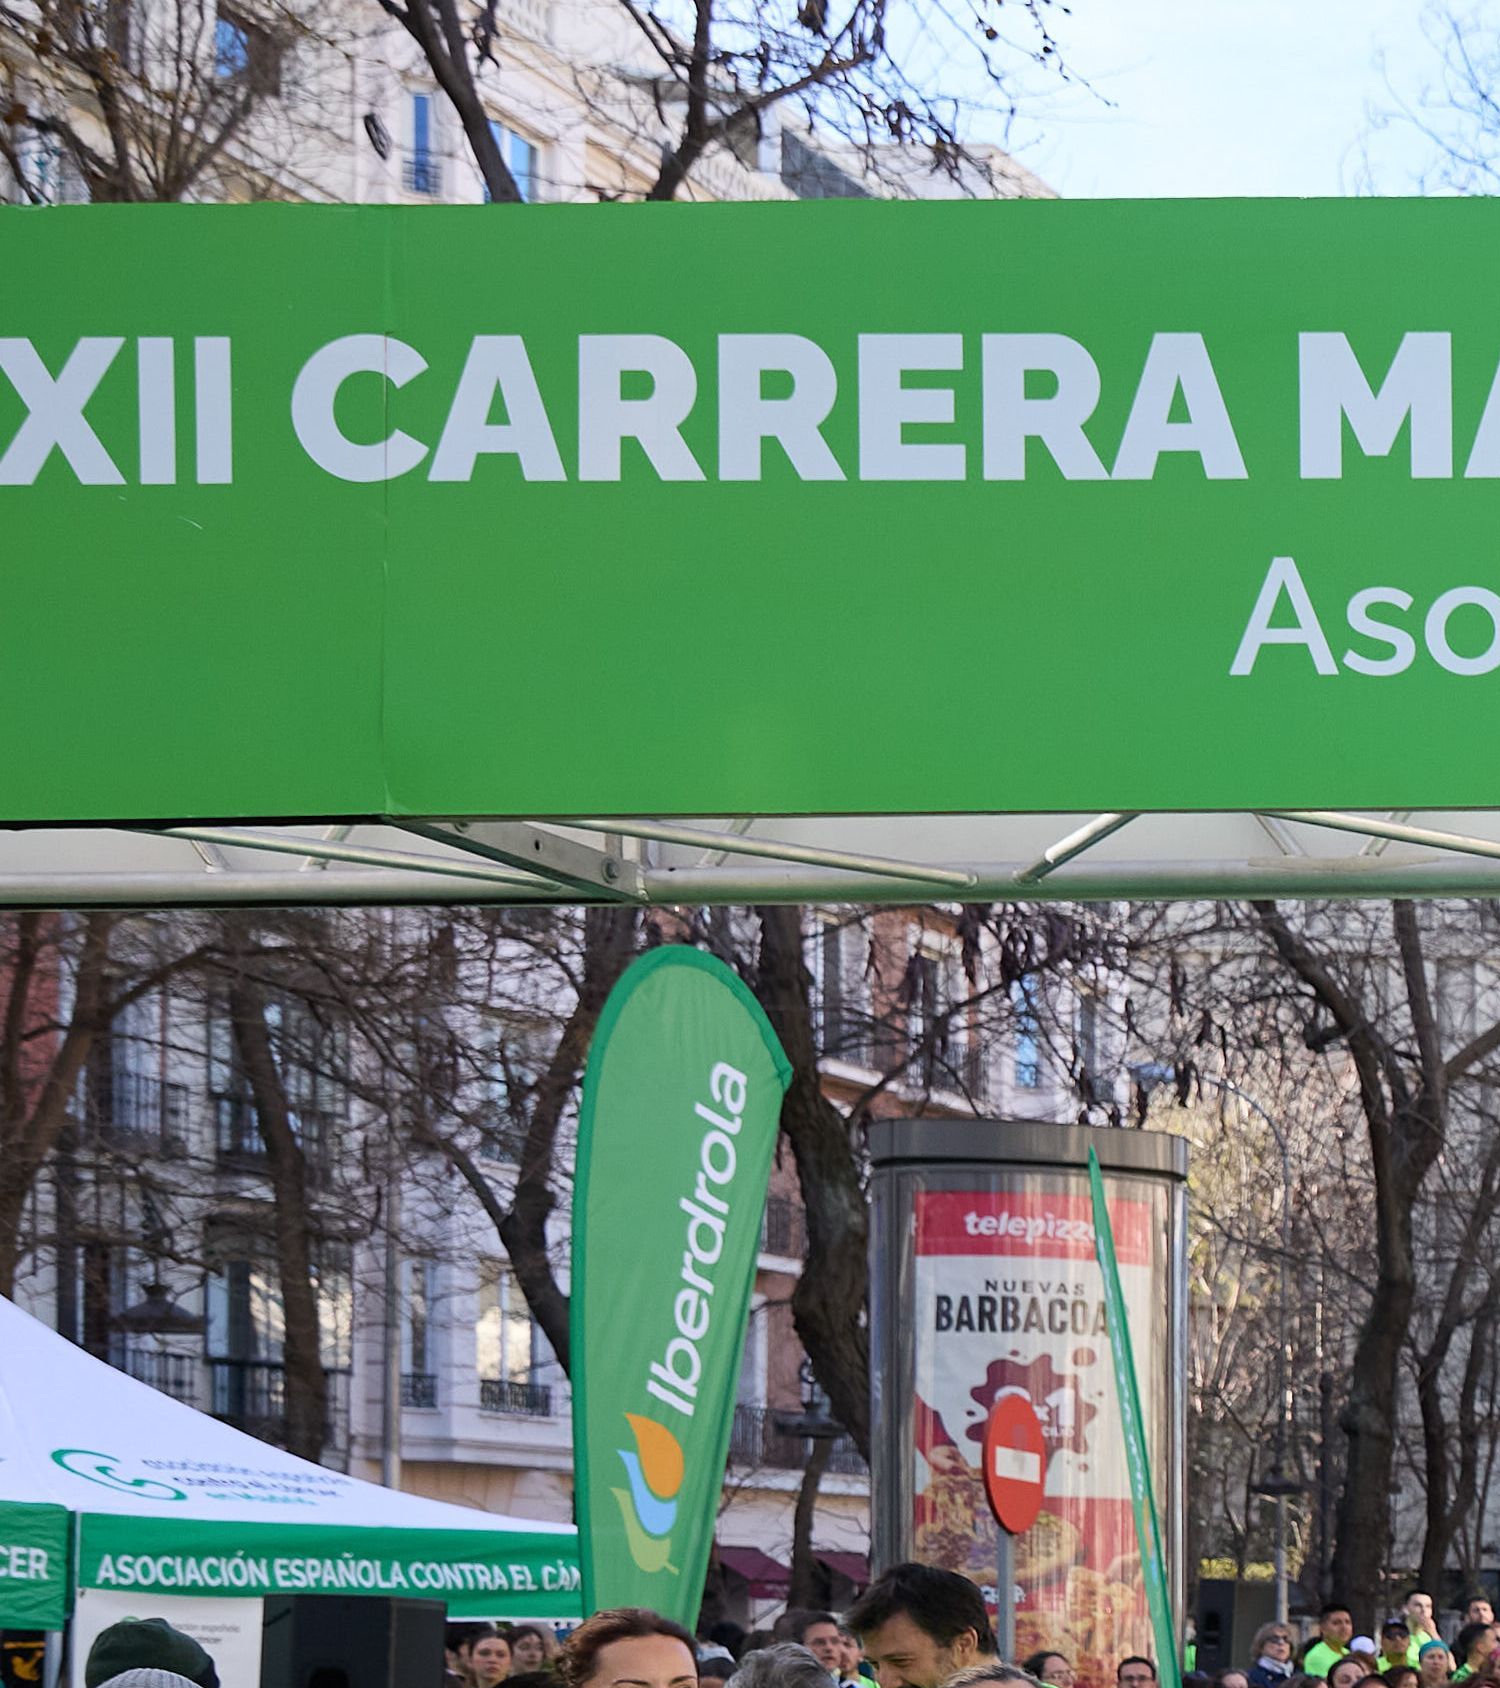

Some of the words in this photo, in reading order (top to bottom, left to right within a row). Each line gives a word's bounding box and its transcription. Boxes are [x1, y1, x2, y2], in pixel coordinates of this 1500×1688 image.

[0, 336, 232, 485] XII
[291, 331, 1249, 483] CARRERA
[647, 1059, 750, 1416] Iberdrola
[985, 1279, 1085, 1296] NUEVAS
[935, 1294, 1111, 1338] BARBACOA
[97, 1550, 271, 1588] ASOCIACIÓN
[273, 1553, 405, 1590] ESPAÑOLA
[408, 1562, 509, 1591] CONTRA
[512, 1565, 537, 1591] EL
[541, 1558, 581, 1593] CÁN
